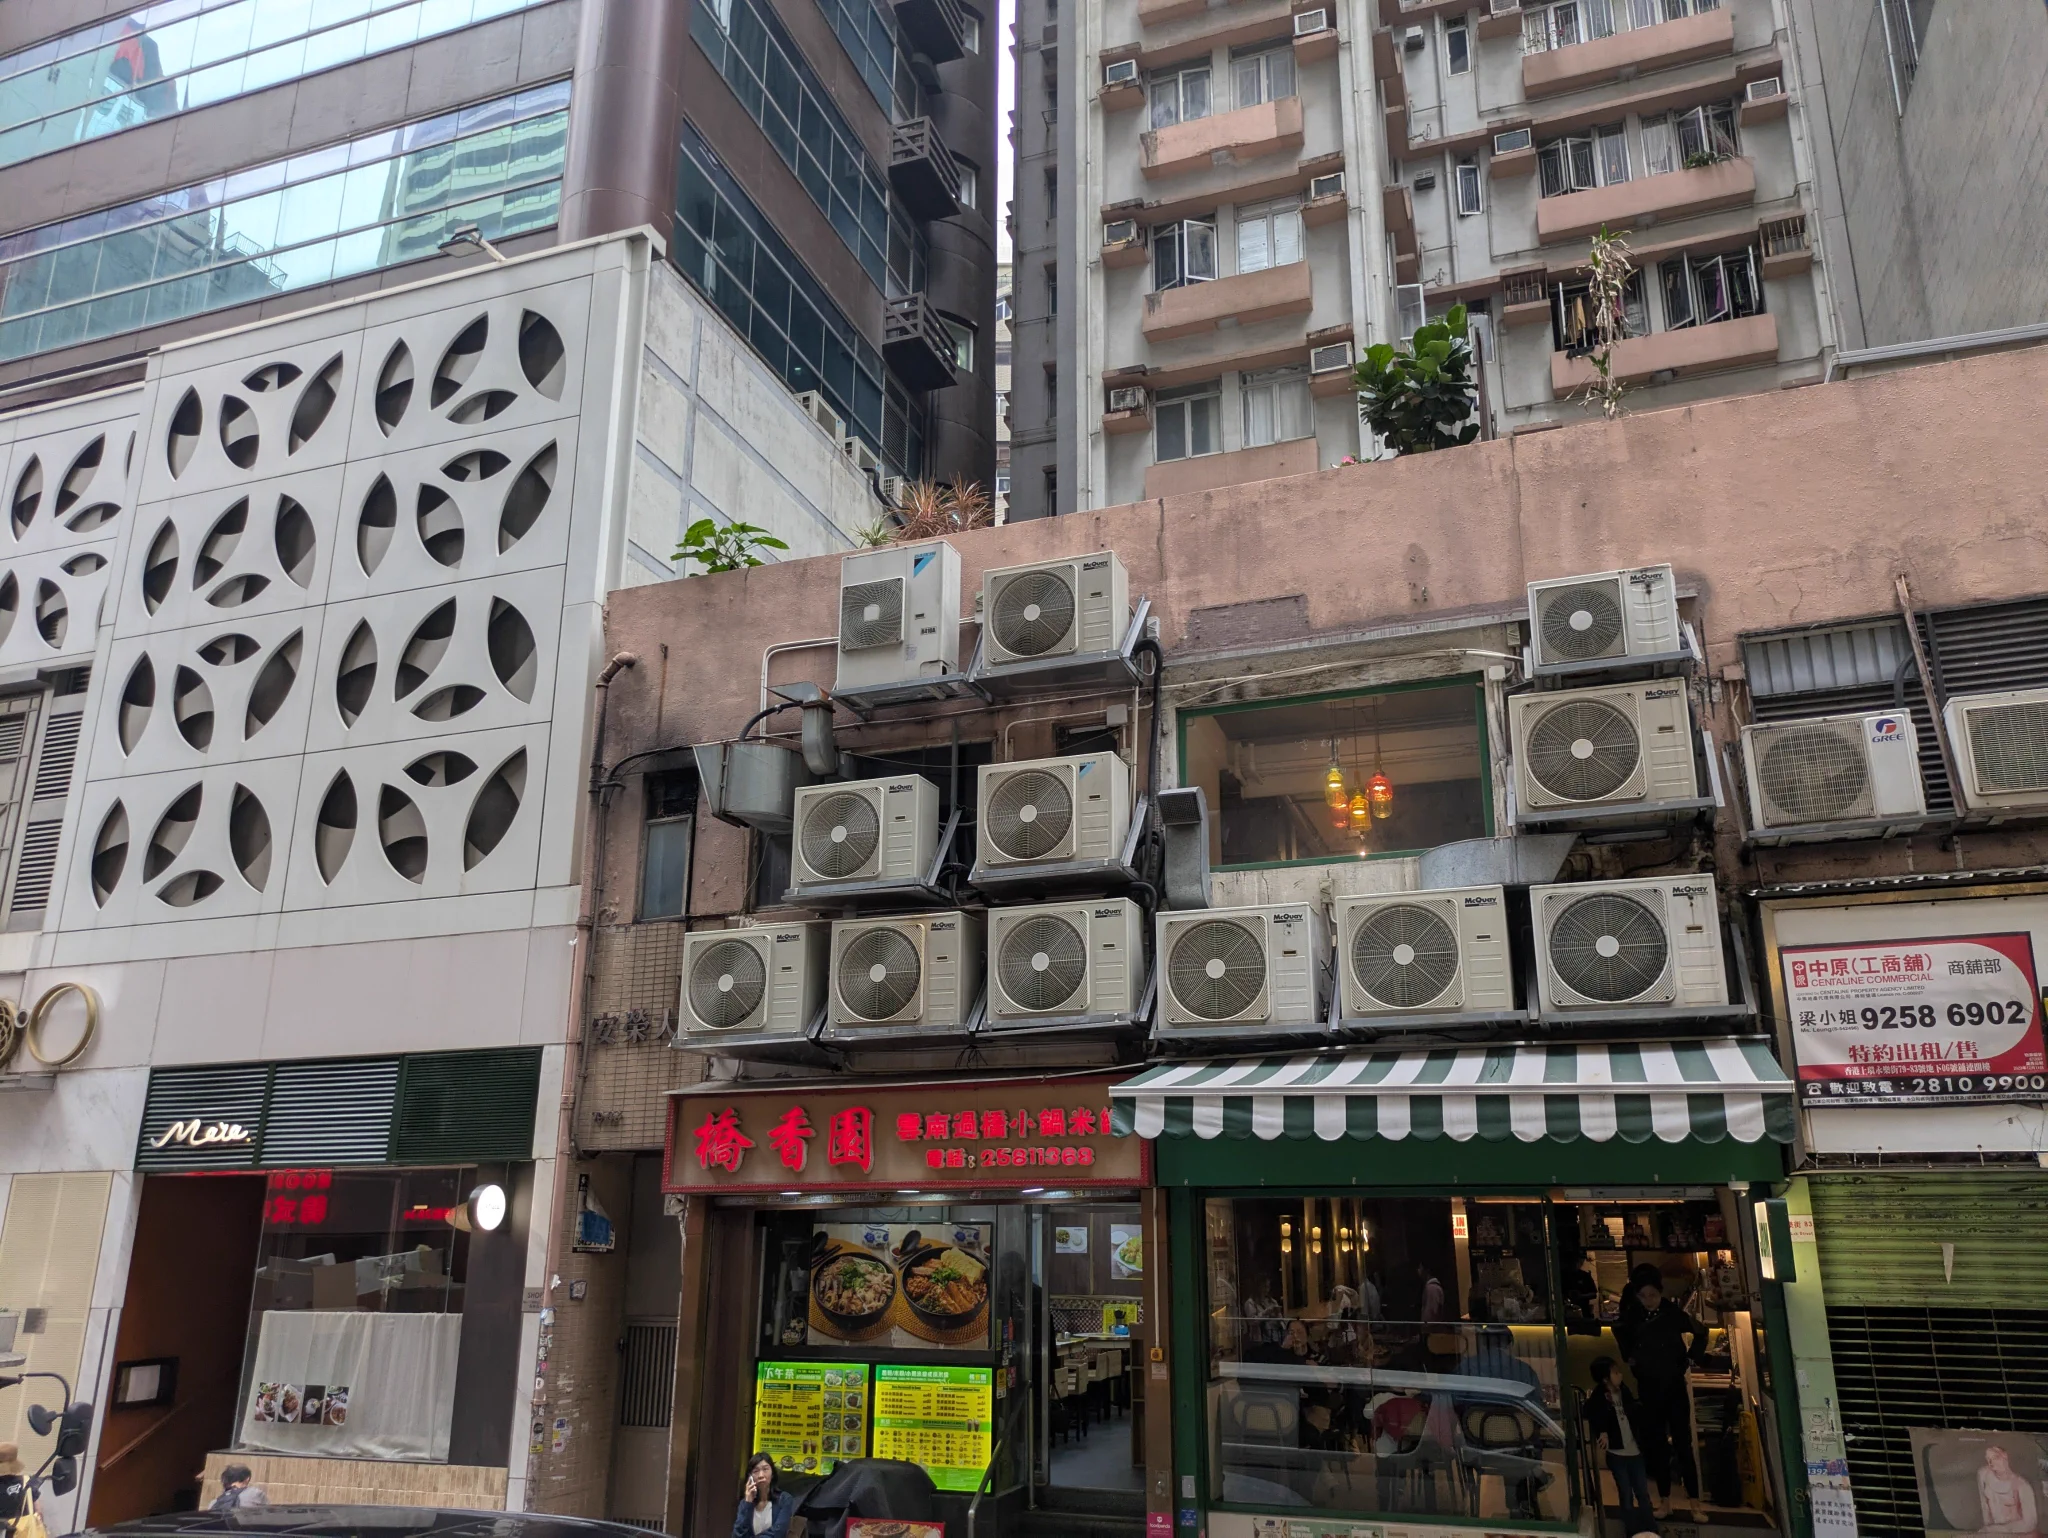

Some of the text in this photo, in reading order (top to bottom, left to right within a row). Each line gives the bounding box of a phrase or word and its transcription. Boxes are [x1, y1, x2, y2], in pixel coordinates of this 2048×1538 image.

[1083, 560, 1109, 569] McQuay
[1629, 573, 1663, 581] McQuay
[1645, 688, 1679, 697] McQuay
[1872, 733, 1904, 743] GREE
[1094, 908, 1122, 916] McQuay
[1947, 958, 2003, 976] 商舖部
[1811, 973, 1934, 988] CENTALINE COMMERCIAL
[1799, 1001, 2026, 1031] 梁小姐 9258 6902
[1848, 1041, 1979, 1062] 特約出租/售
[1912, 1077, 1974, 1094] 2810
[1982, 1075, 2046, 1091] 9900
[693, 1106, 876, 1174] 橋香園
[980, 1147, 1096, 1168] 25811368
[763, 1368, 795, 1380] 下午茶
